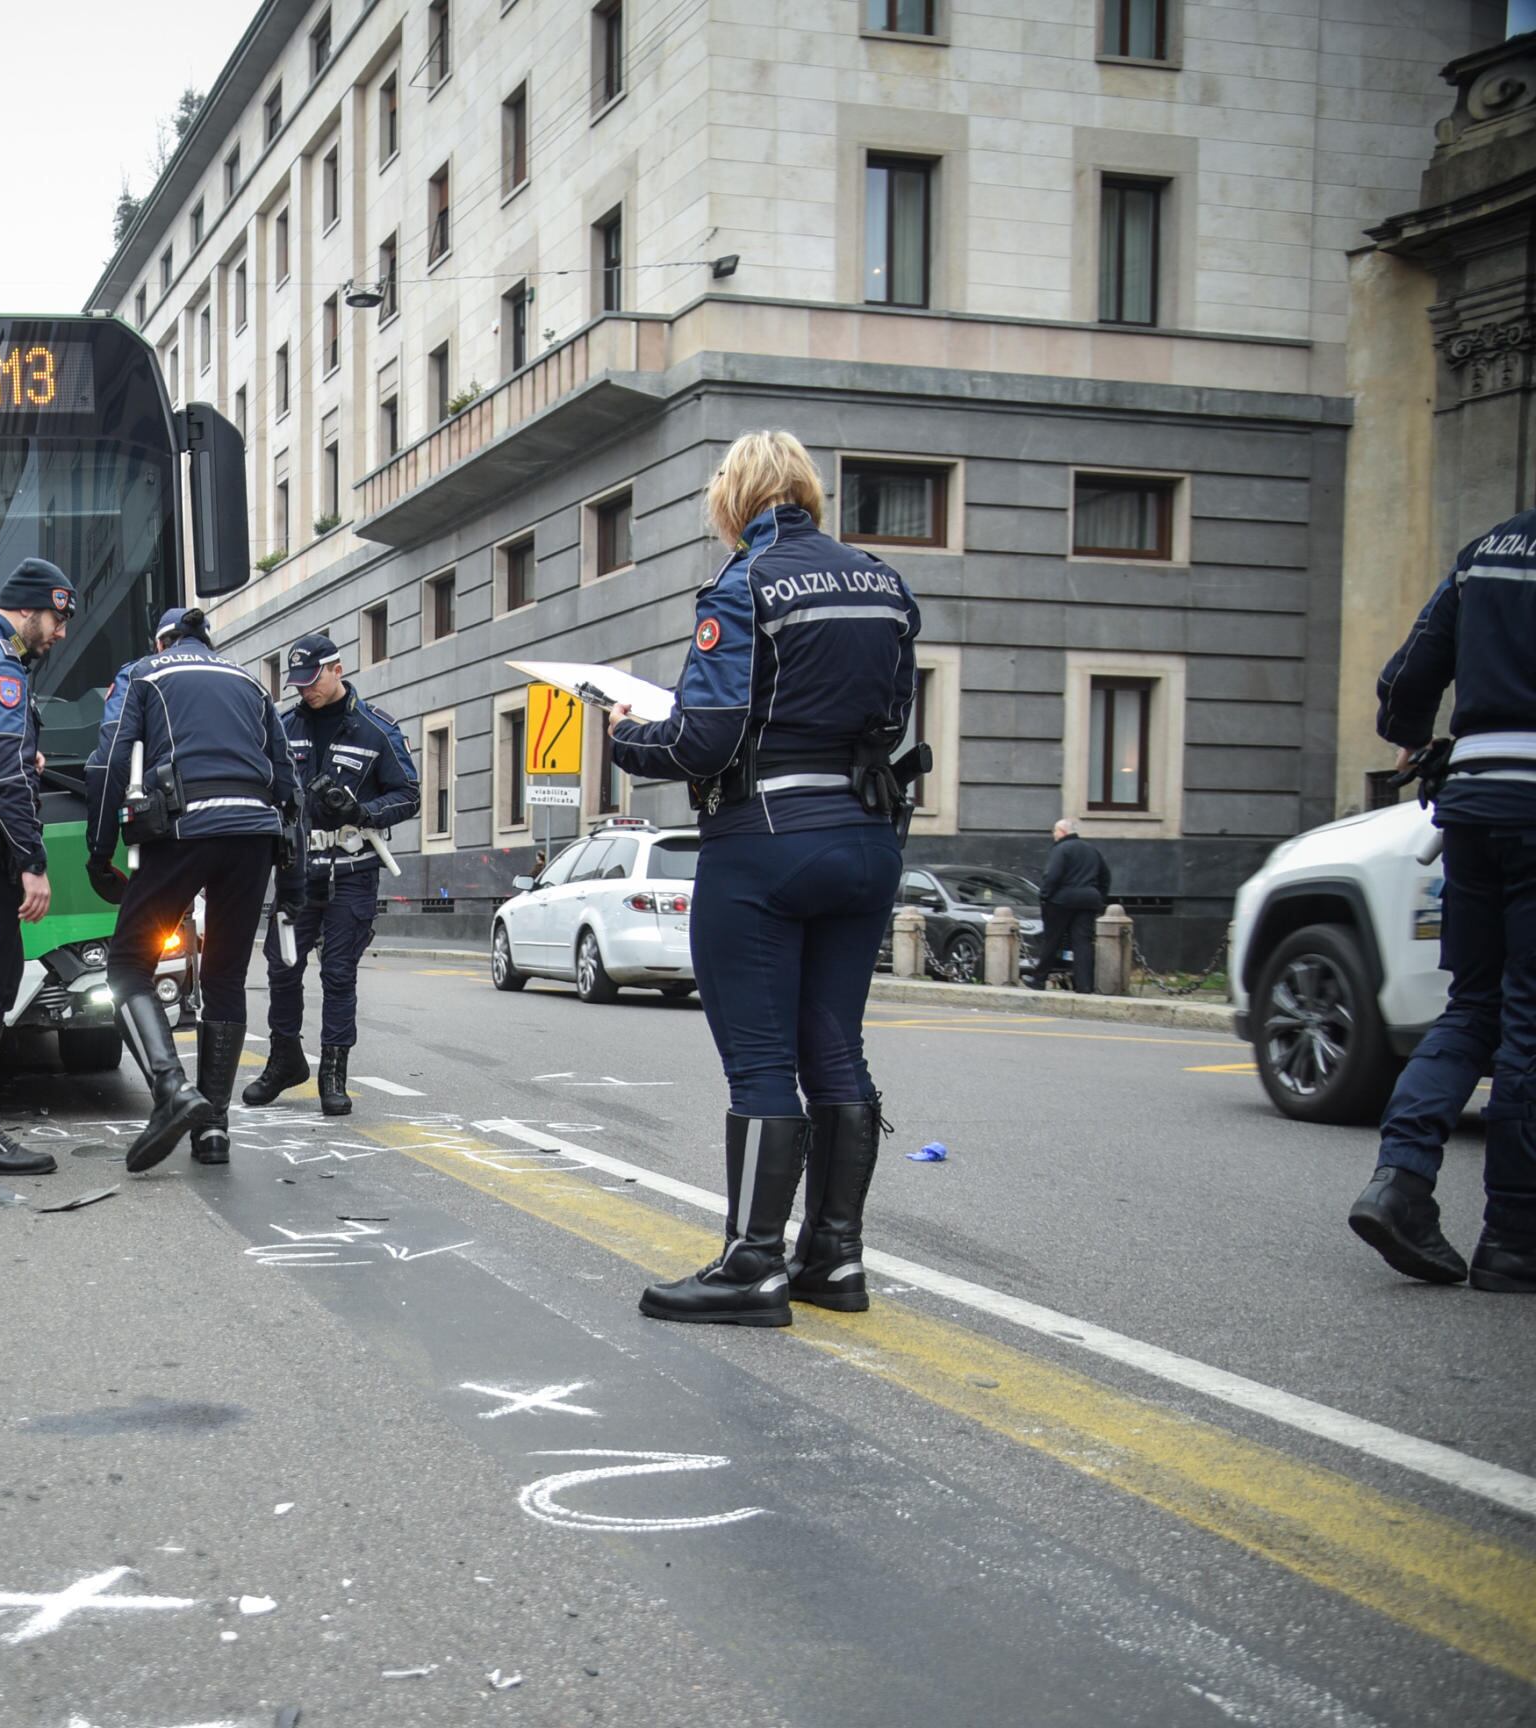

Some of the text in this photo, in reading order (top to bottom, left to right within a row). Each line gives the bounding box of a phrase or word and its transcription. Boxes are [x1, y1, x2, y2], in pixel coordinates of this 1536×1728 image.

[760, 571, 901, 606] POLIZIA LOCALE
[150, 653, 205, 668] POLIZIA
[530, 796, 574, 804] modificata
